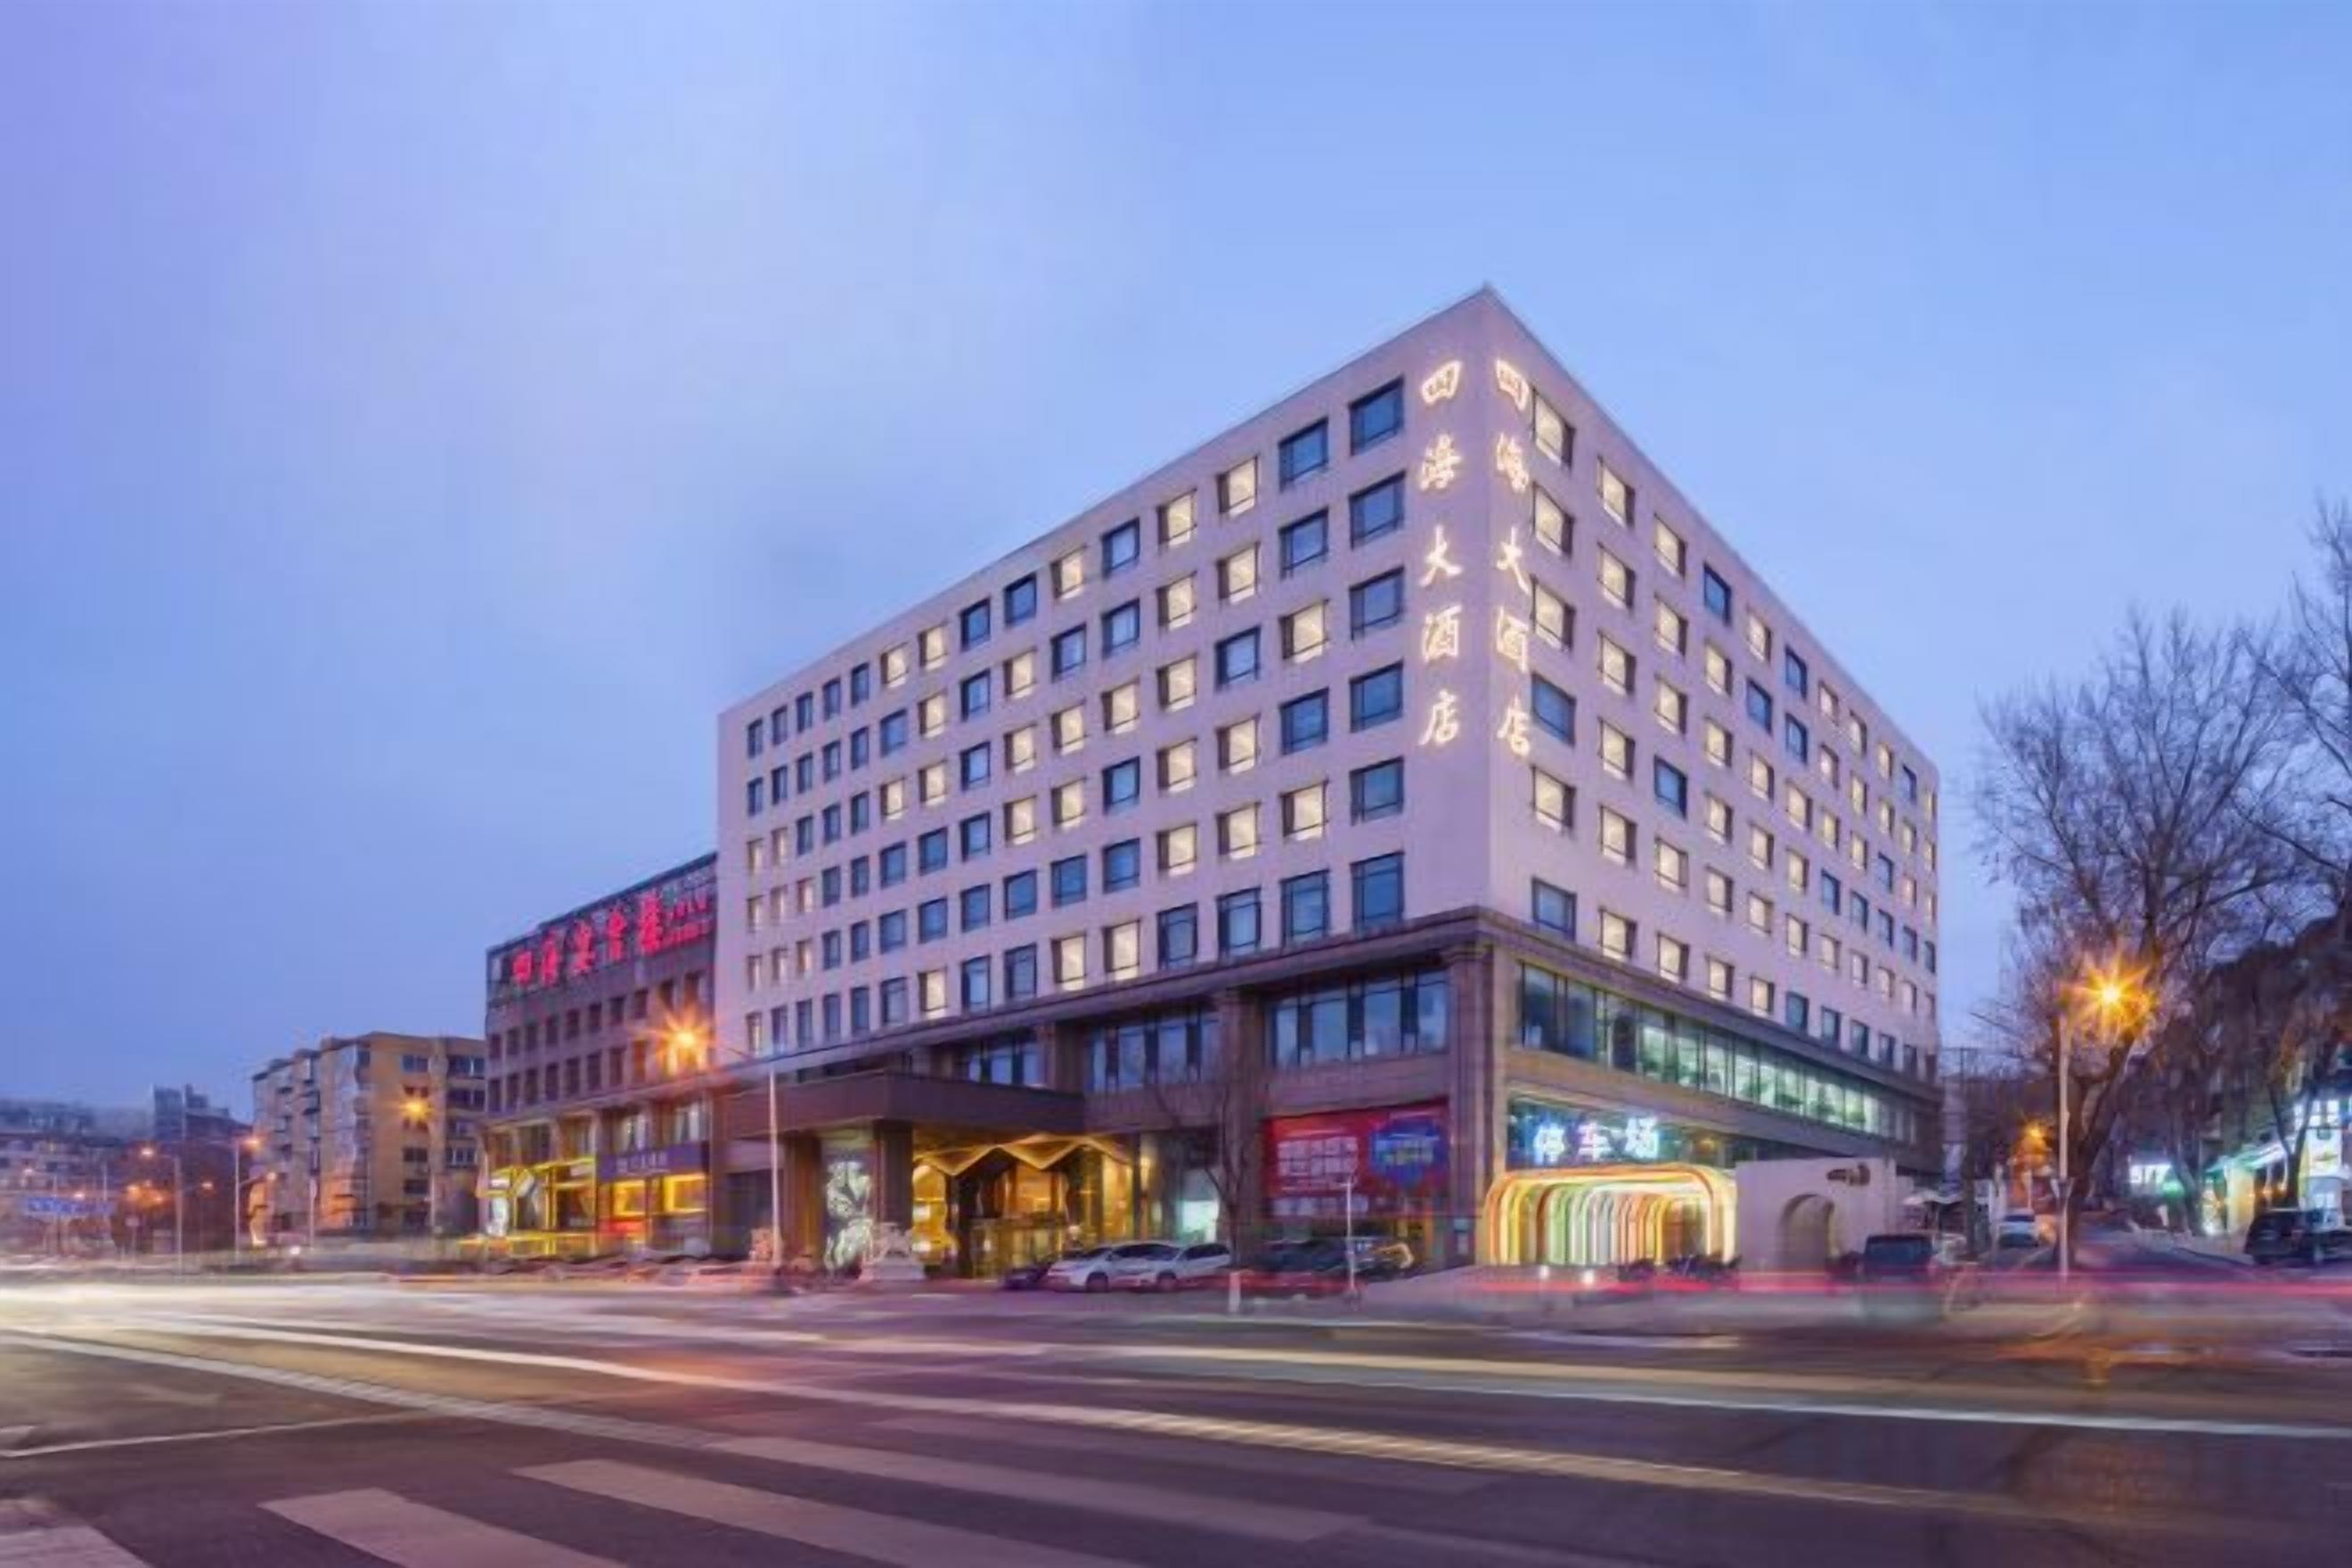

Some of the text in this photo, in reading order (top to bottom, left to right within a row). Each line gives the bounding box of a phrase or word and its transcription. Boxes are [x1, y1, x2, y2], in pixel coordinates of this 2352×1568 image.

[1420, 359, 1463, 747] 四海大酒店
[1495, 358, 1531, 757] 四海大酒店
[1532, 1116, 1659, 1164] 停车场
